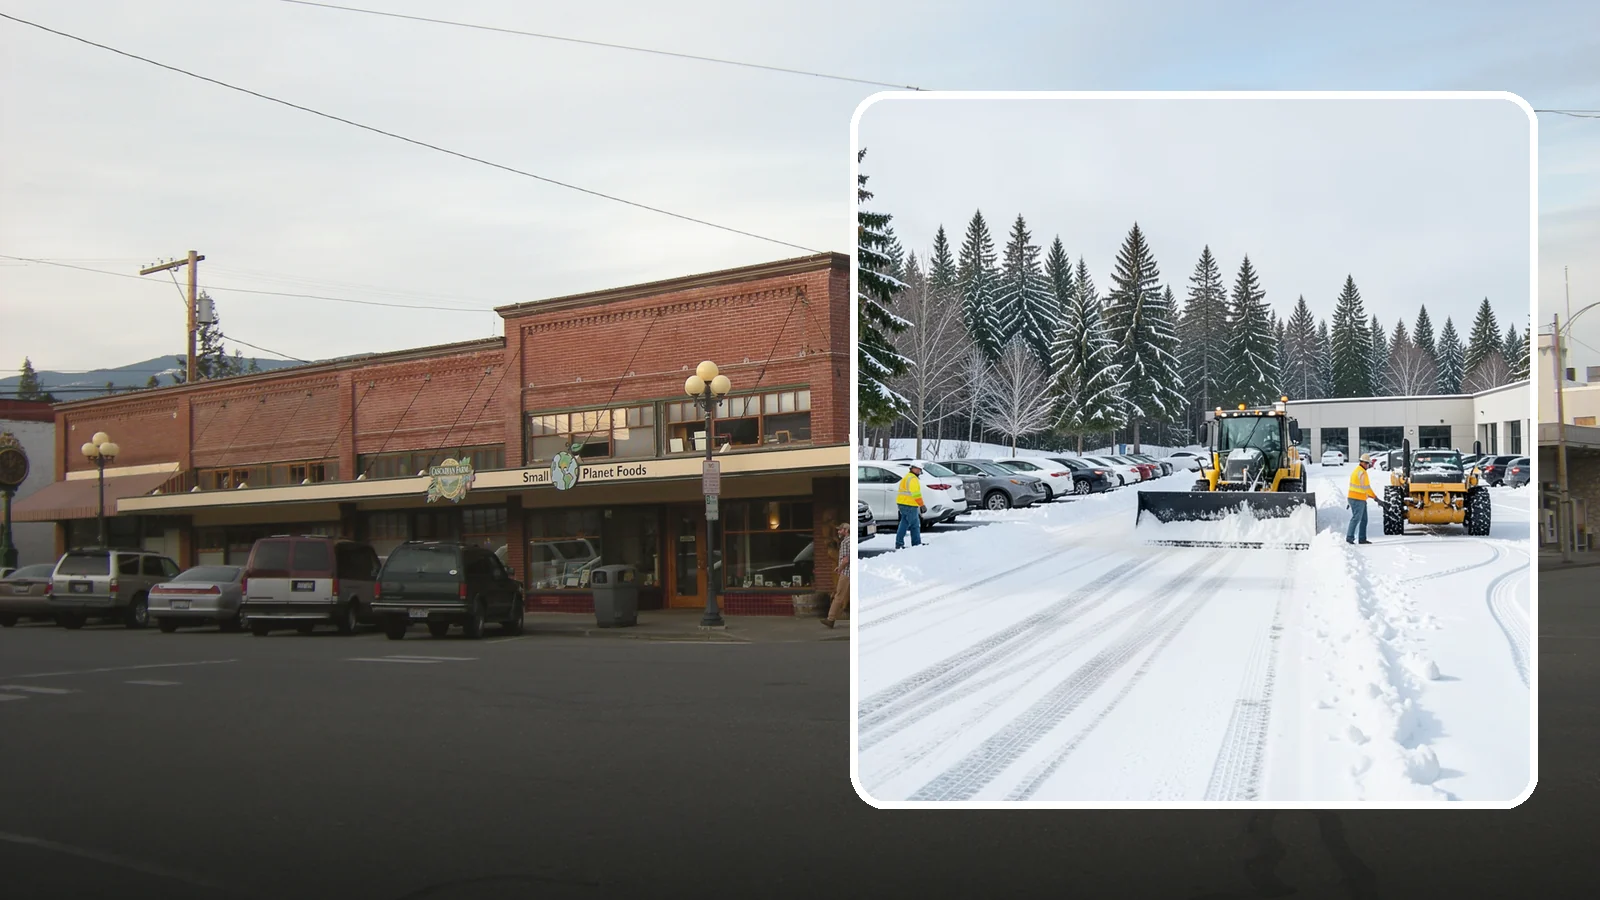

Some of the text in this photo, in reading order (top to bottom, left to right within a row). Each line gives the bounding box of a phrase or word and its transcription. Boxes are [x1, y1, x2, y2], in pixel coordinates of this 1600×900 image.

[432, 465, 469, 475] CASCADIAN FARM
[523, 464, 647, 482] Small Planet Foods
